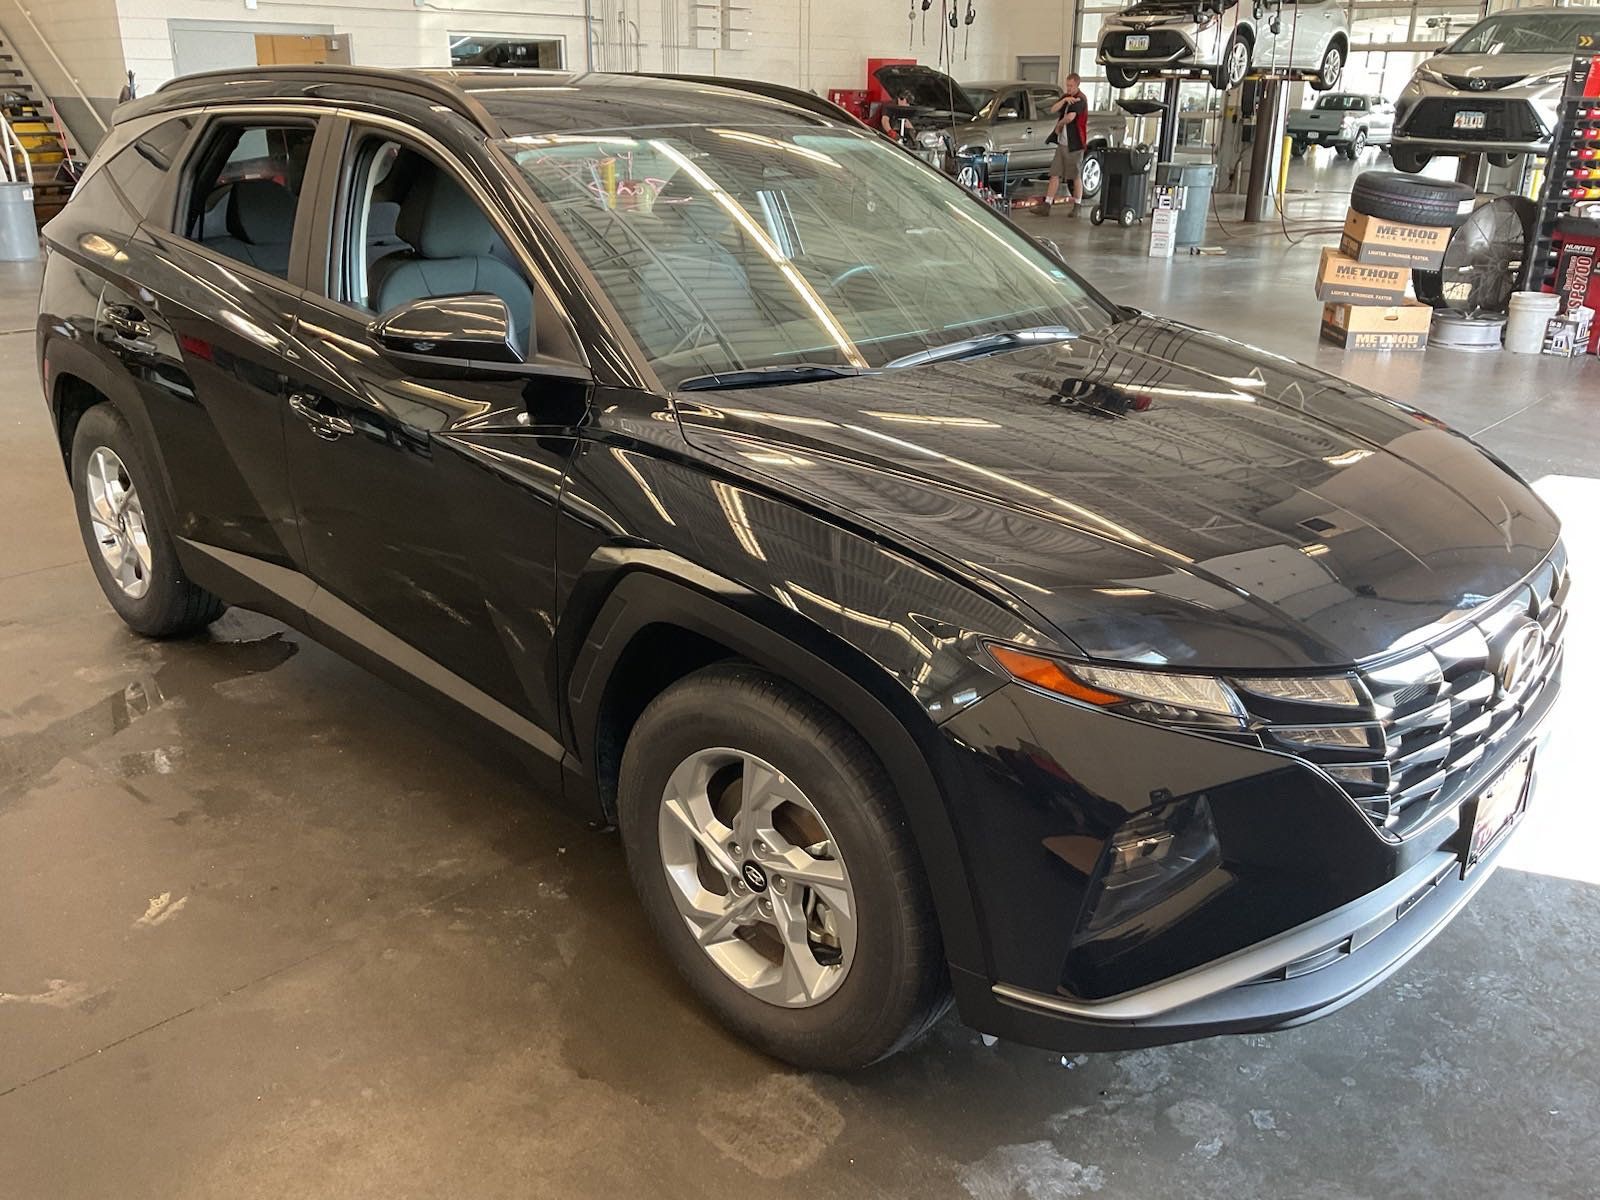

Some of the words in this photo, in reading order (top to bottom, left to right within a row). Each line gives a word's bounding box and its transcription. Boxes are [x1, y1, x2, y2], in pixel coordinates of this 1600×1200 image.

[1376, 225, 1438, 240] METHOD
[1565, 244, 1596, 252] HUNTER
[1336, 265, 1399, 279] METHOD
[1567, 255, 1592, 311] SP9700
[1355, 334, 1419, 343] METHOD
